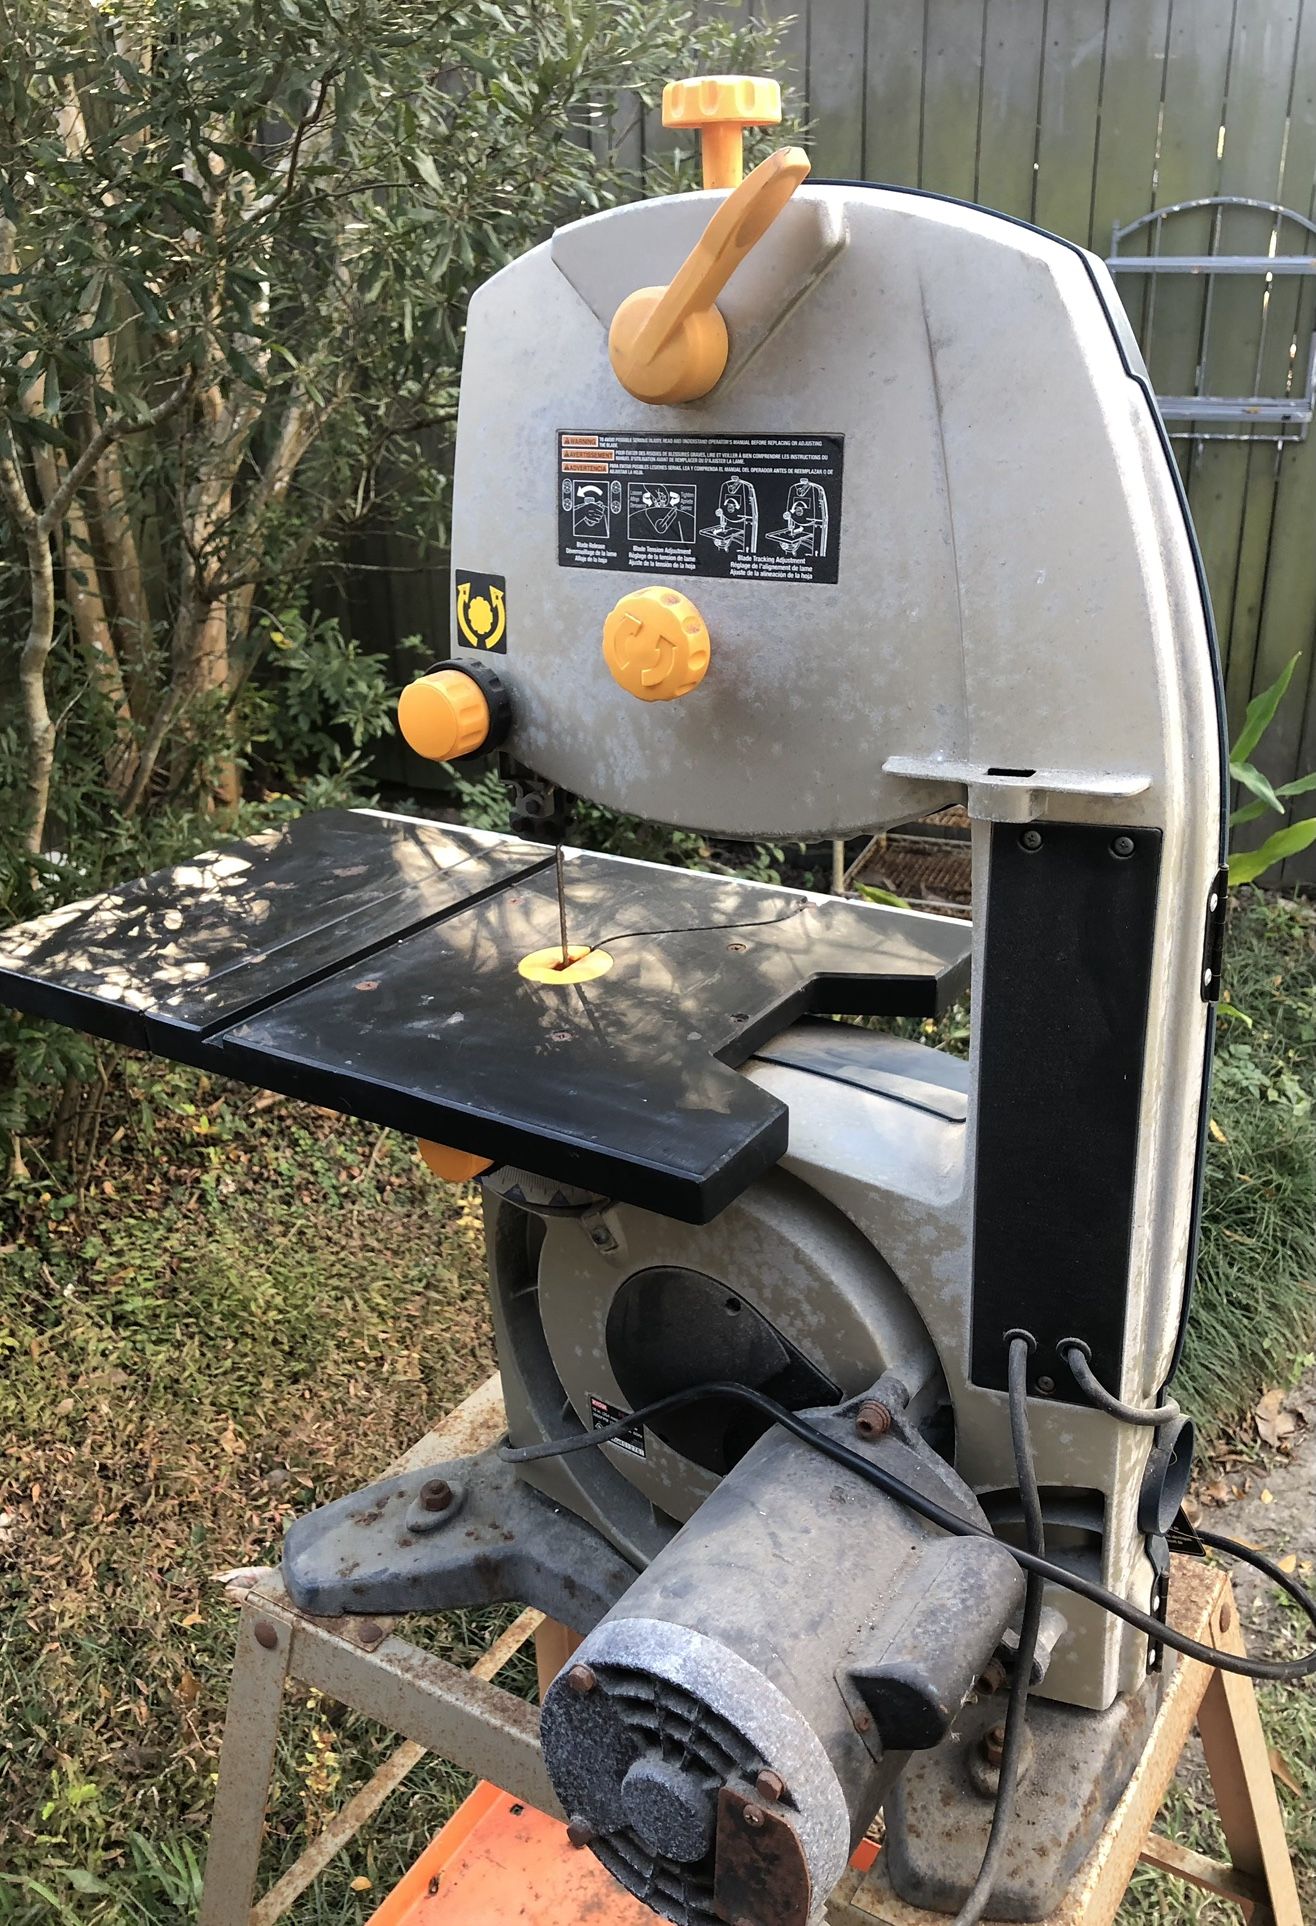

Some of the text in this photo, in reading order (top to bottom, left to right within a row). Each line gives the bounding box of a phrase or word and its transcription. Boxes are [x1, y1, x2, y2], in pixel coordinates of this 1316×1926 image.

[570, 451, 612, 459] AVERTISSEMENT
[665, 547, 691, 555] Adjustment
[628, 552, 646, 560] Réglage
[753, 556, 775, 564] Tracking
[776, 556, 806, 564] Adjustment
[730, 561, 751, 569] Réglage
[759, 563, 791, 571] l'alignement
